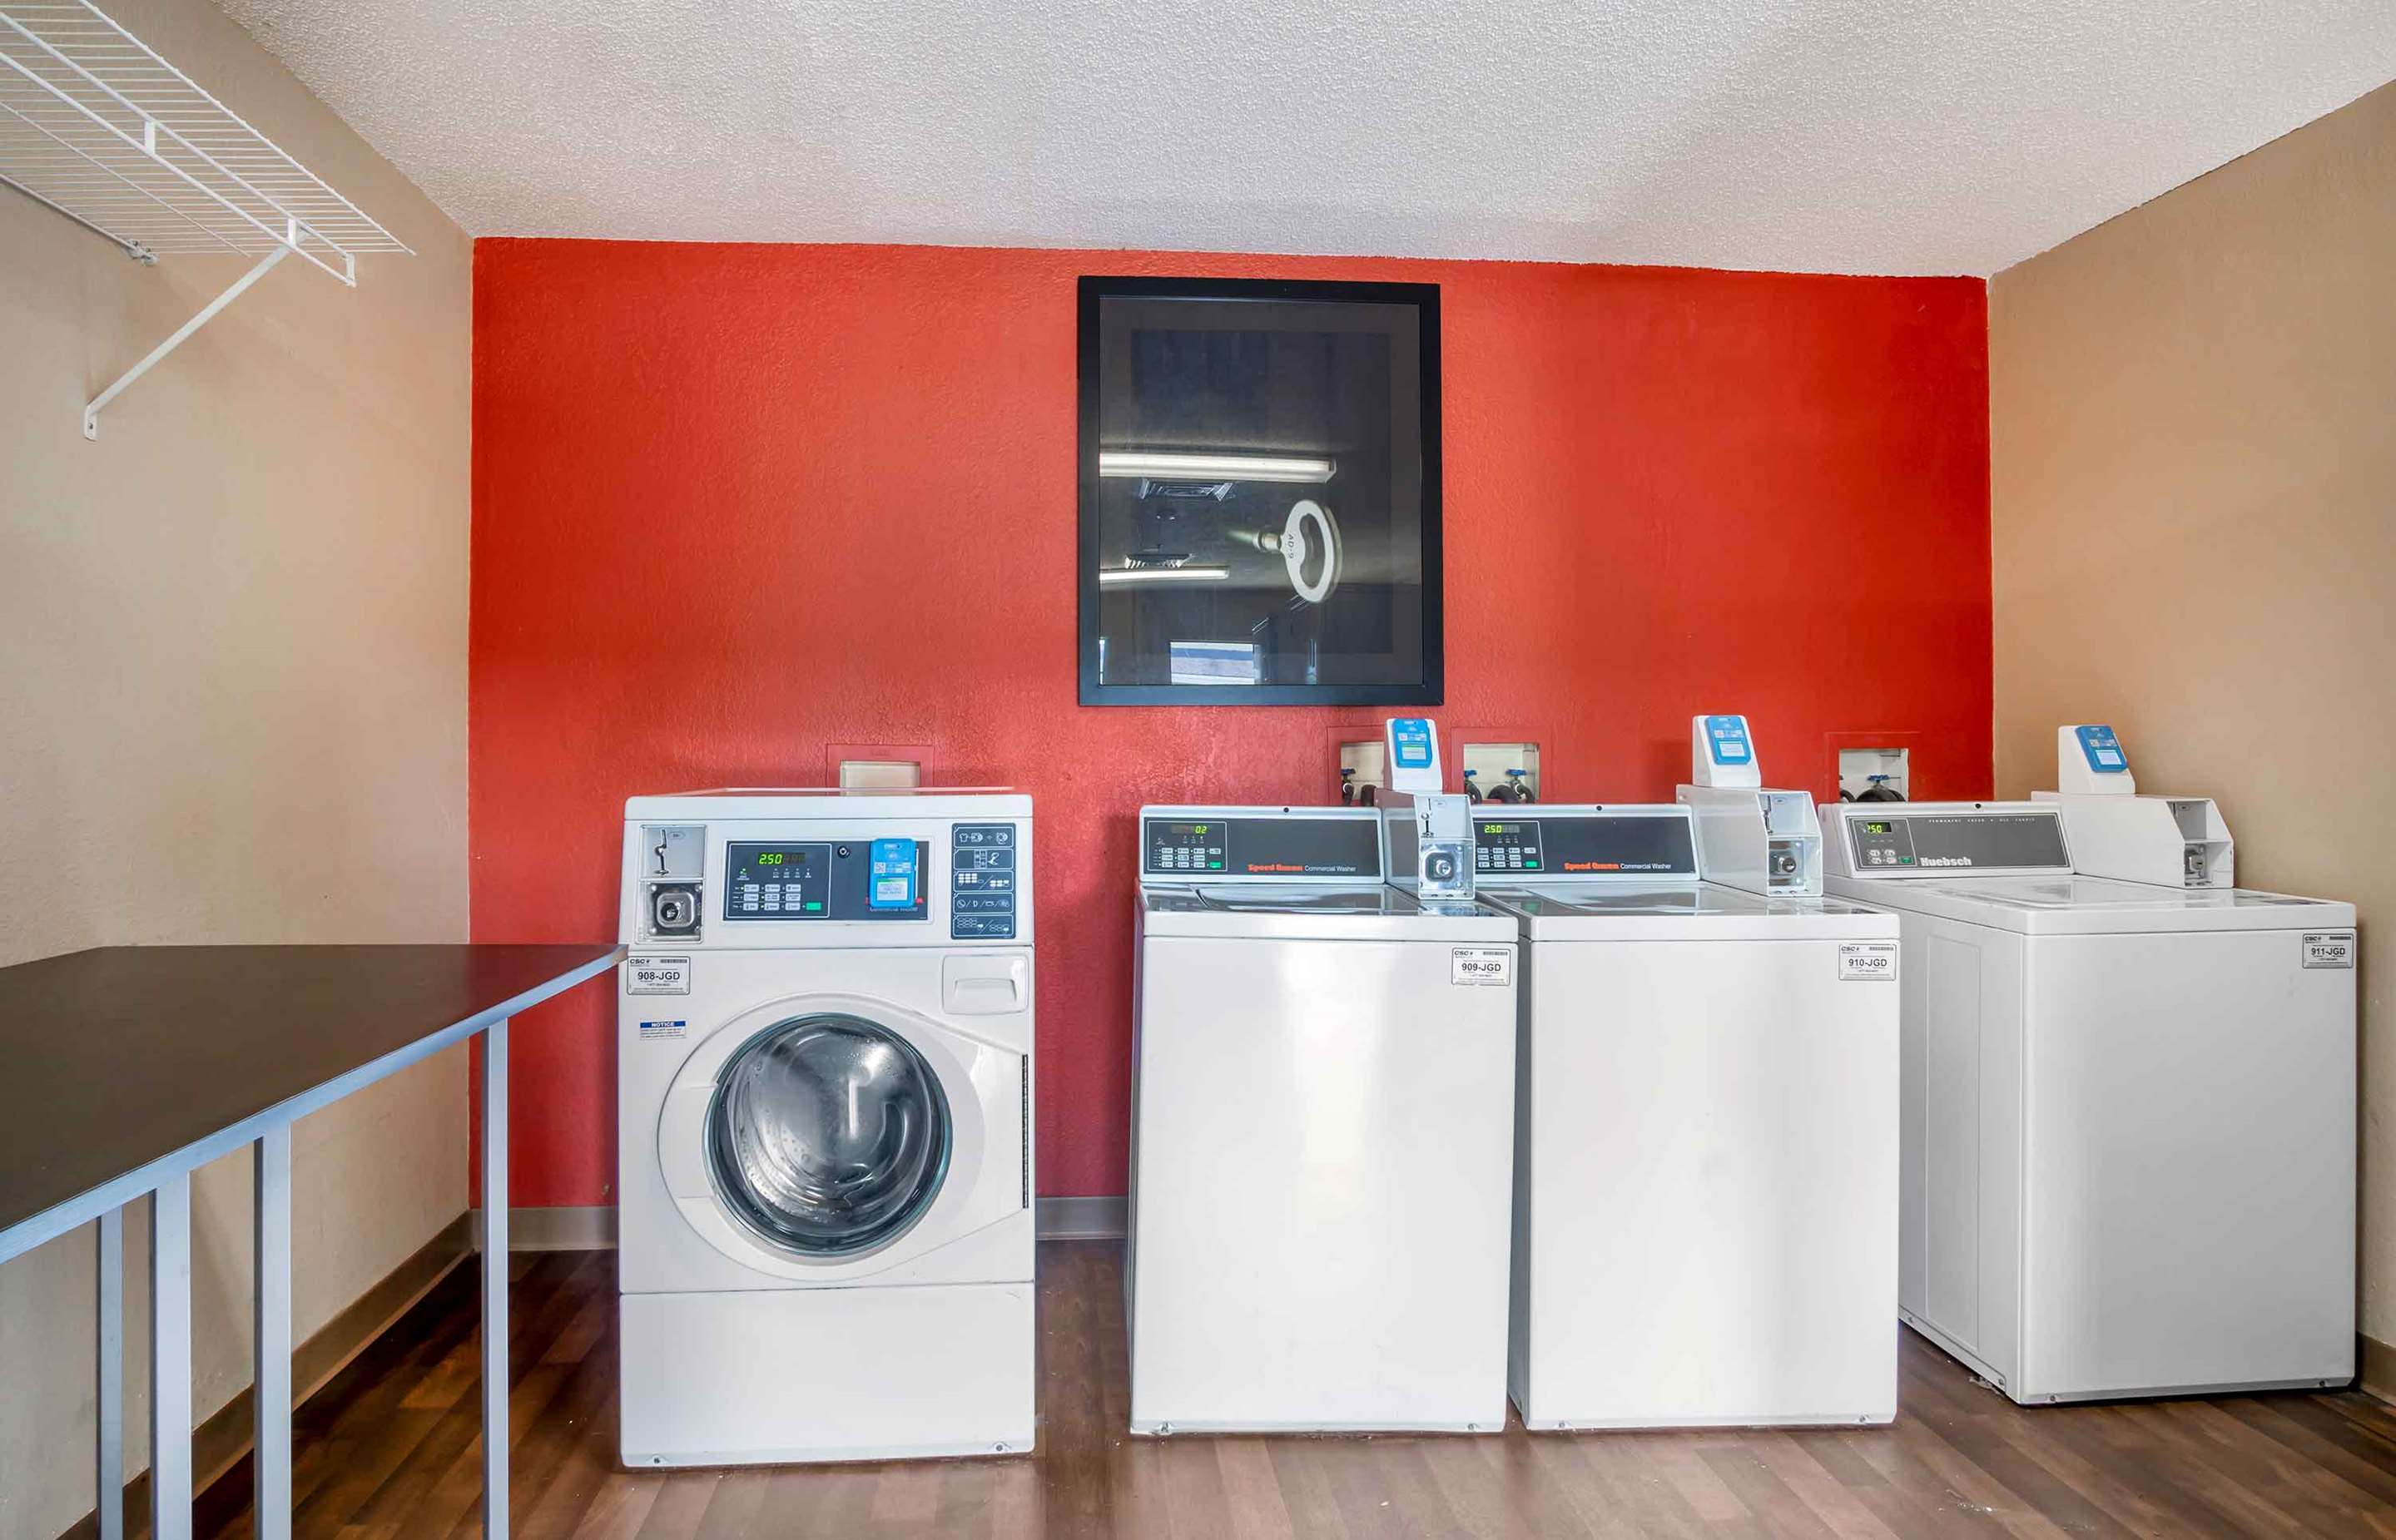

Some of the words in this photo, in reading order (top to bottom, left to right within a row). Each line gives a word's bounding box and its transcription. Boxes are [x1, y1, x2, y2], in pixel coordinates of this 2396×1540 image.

[1194, 825, 1208, 834] 02
[1920, 856, 1972, 866] Huebsch
[1848, 958, 1888, 967] 910-JGD
[1461, 963, 1501, 972] 909-JGD
[637, 971, 681, 980] 908-JGD
